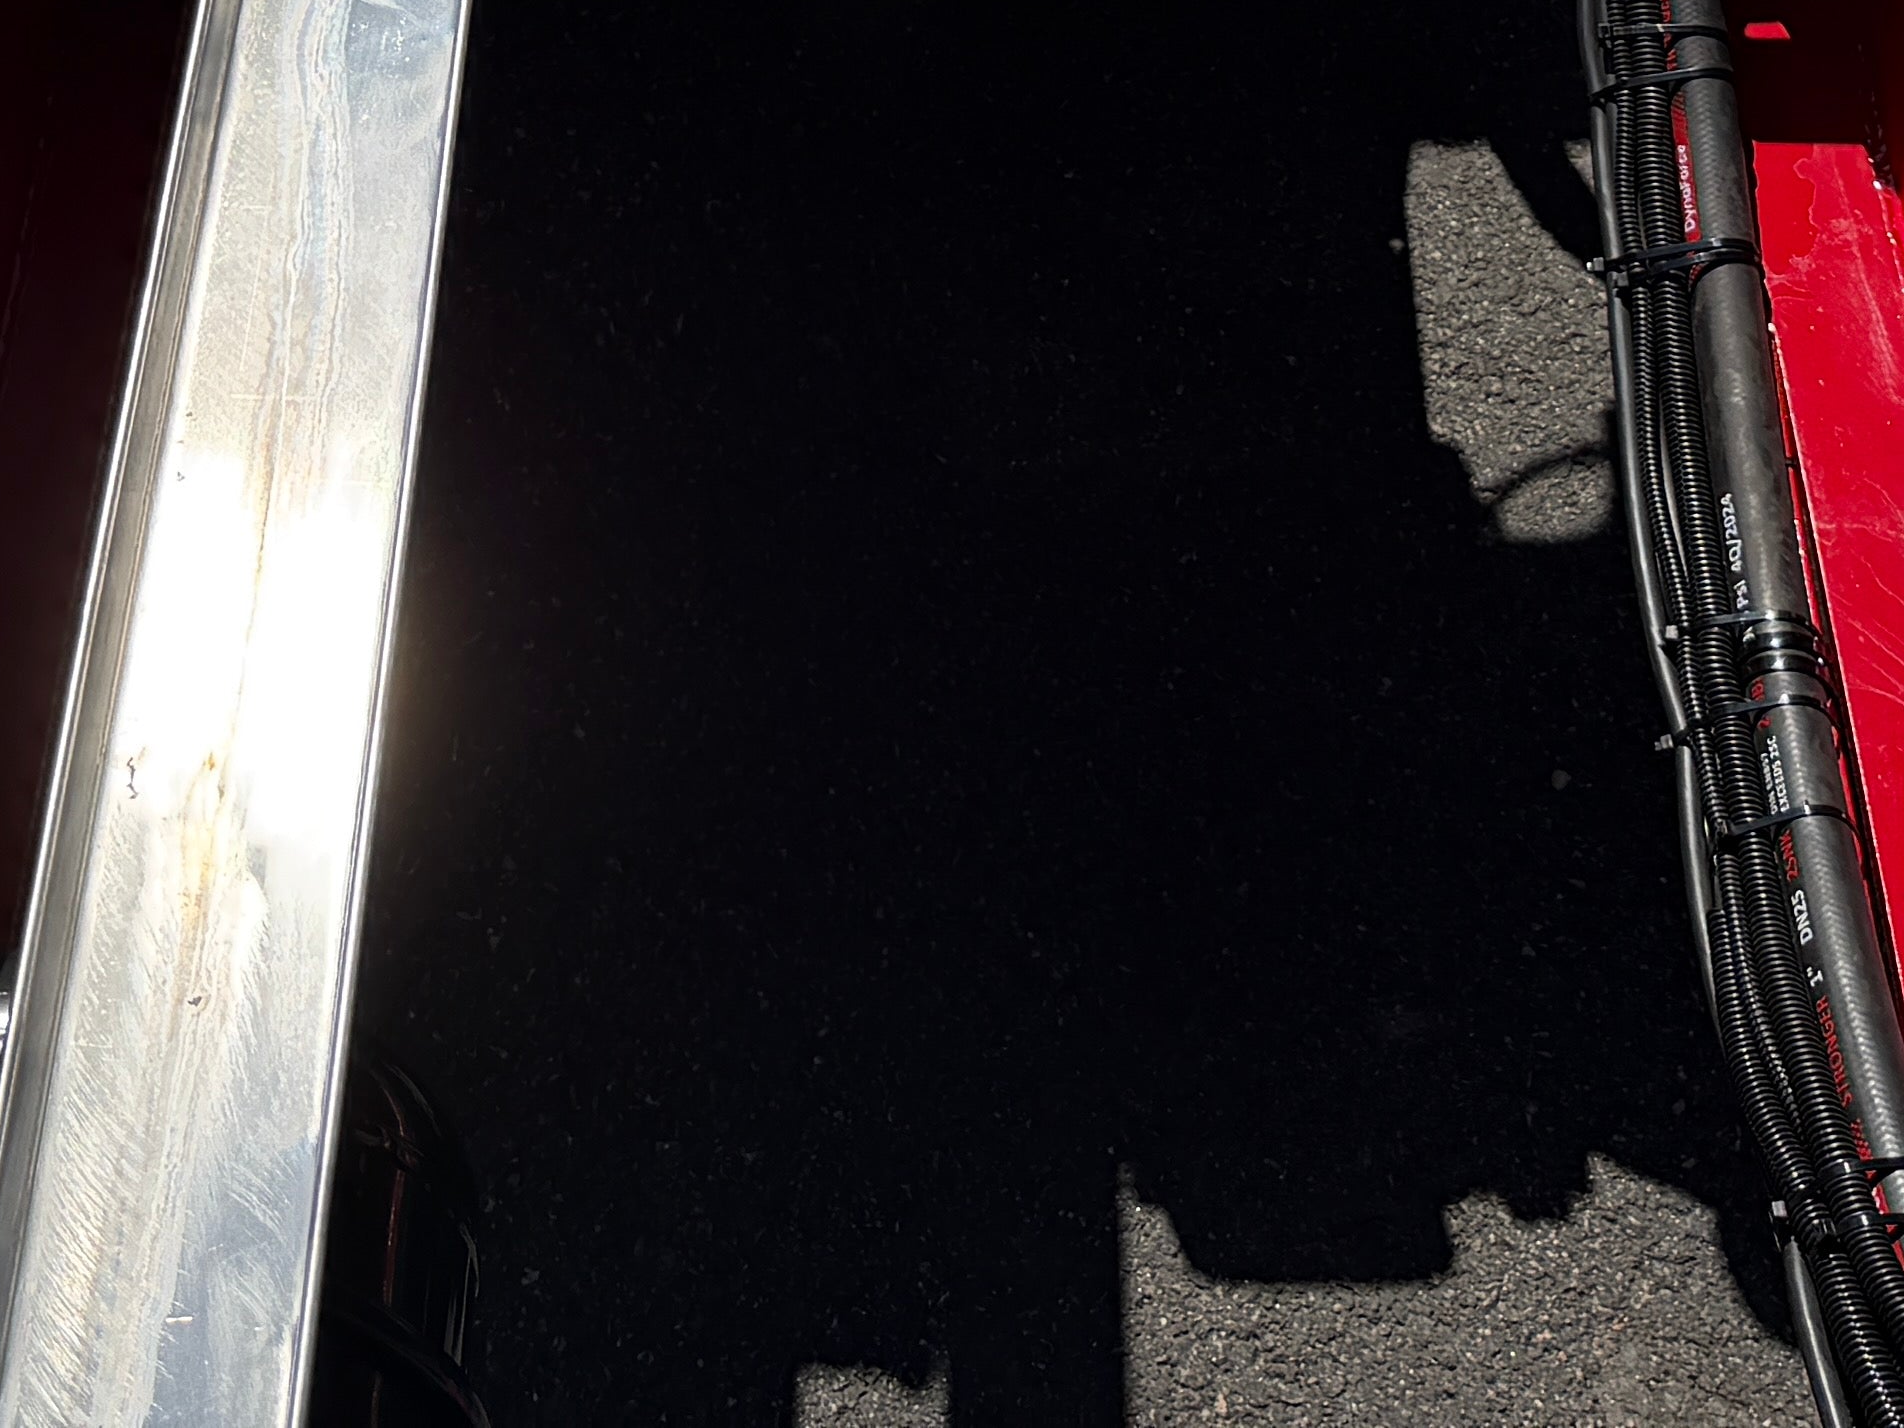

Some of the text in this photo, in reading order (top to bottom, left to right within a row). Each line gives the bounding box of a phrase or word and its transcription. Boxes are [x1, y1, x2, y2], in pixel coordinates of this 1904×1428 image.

[1675, 144, 1697, 233] DynaForce
[1720, 493, 1743, 573] 4Q/2024
[1790, 889, 1814, 946] DN25
[1805, 965, 1824, 988] 1"
[1814, 994, 1854, 1110] STRONGER
